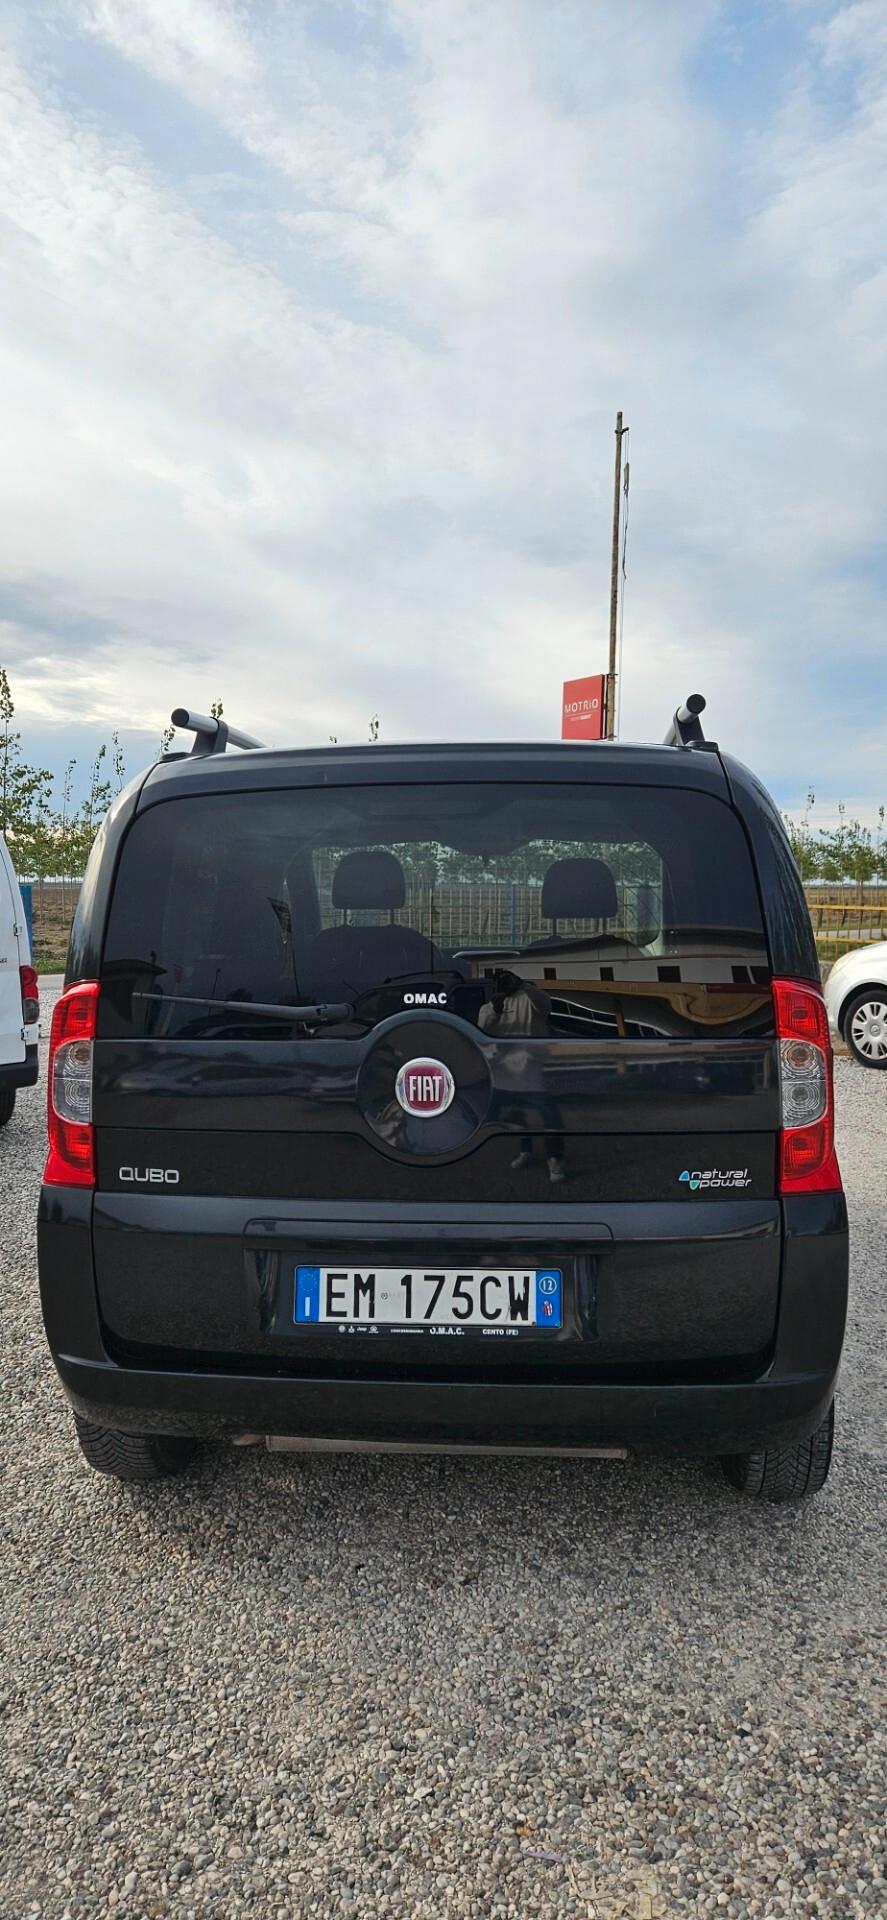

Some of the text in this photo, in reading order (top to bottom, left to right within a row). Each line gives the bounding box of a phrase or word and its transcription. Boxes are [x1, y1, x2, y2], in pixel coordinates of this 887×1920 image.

[403, 993, 447, 1004] OMAC
[409, 1075, 442, 1101] FIAT
[119, 1166, 179, 1183] QUBO
[691, 1168, 748, 1179] natural
[699, 1179, 752, 1188] power
[542, 1280, 553, 1291] 12
[326, 1273, 530, 1320] EM 175CW
